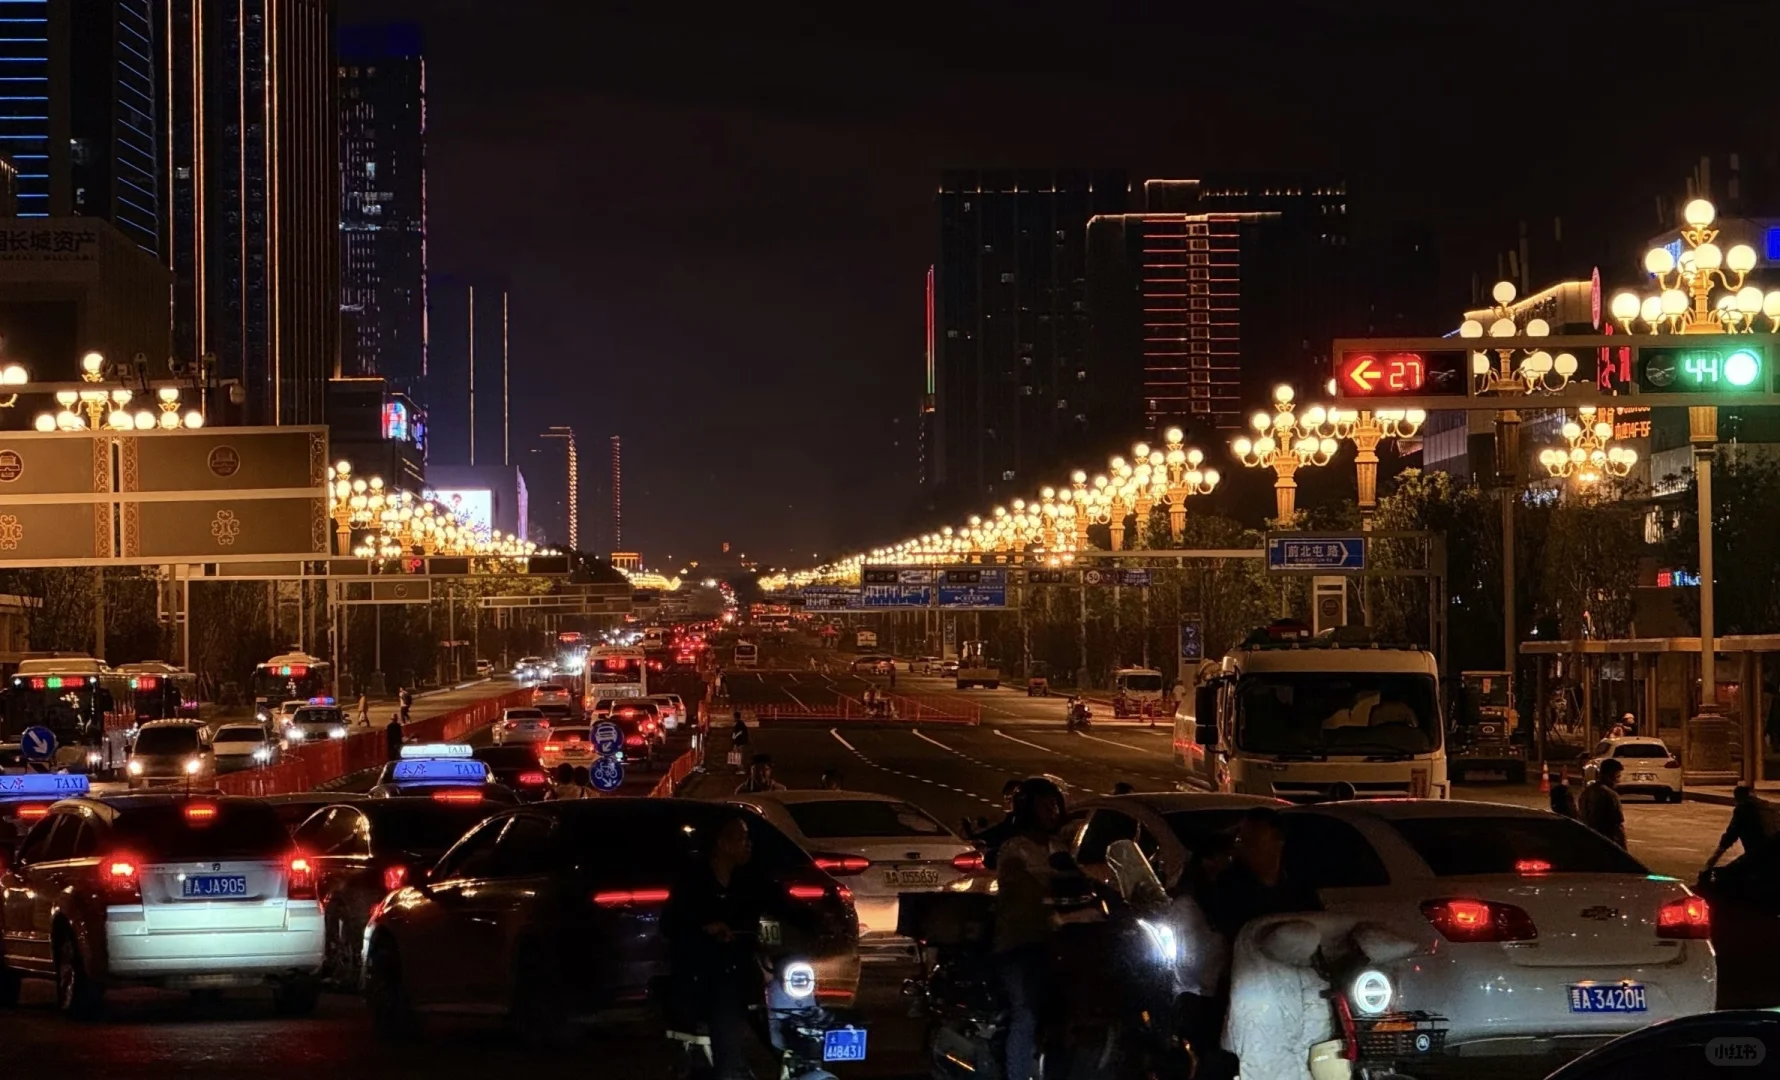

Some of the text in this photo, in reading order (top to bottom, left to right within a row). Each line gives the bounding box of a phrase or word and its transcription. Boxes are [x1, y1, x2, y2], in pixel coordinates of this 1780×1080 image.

[1390, 362, 1420, 388] 27
[1685, 358, 1718, 382] 44
[1288, 545, 1339, 558] 前北屯路
[1088, 573, 1099, 581] 50
[448, 746, 468, 754] TAXI
[455, 764, 482, 775] TAXI
[54, 778, 84, 789] TAXI
